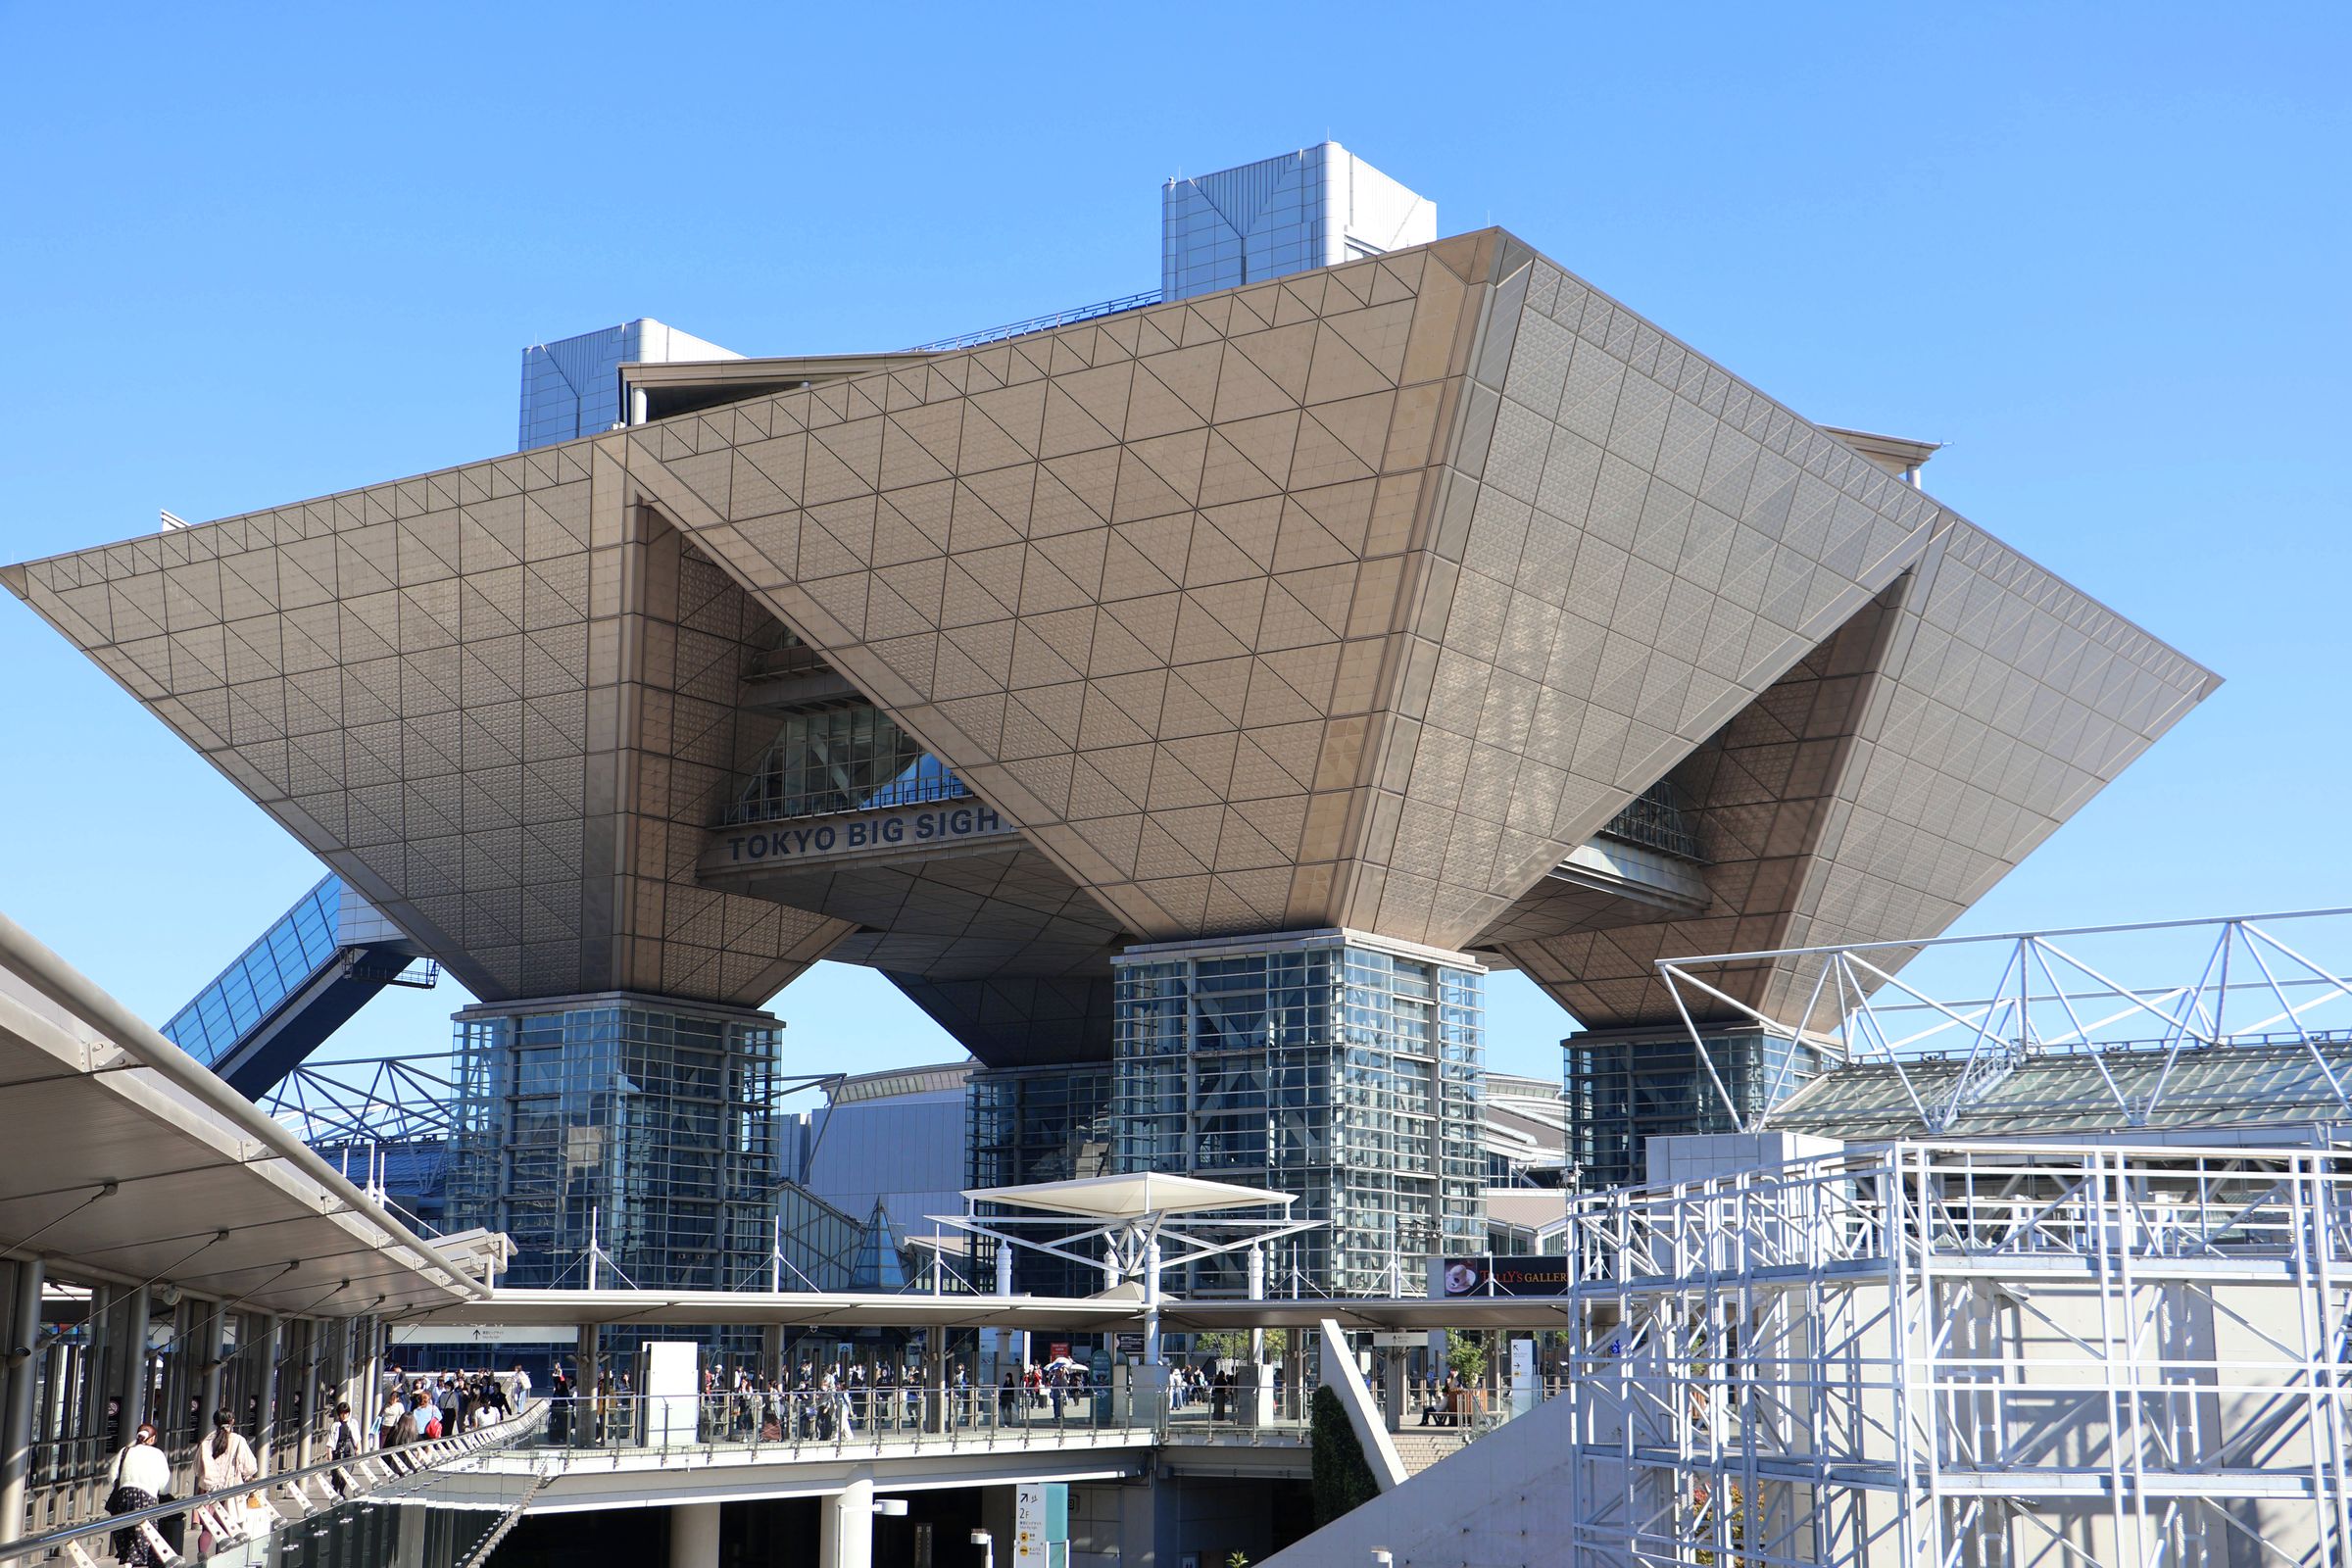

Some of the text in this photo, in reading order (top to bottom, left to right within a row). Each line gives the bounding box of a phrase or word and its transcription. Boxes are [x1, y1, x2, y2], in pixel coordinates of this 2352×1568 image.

[727, 807, 999, 860] TOKYO BIG SIGH
[1480, 1270, 1568, 1283] TLLY'S GALLER
[1019, 1507, 1030, 1519] 2F
